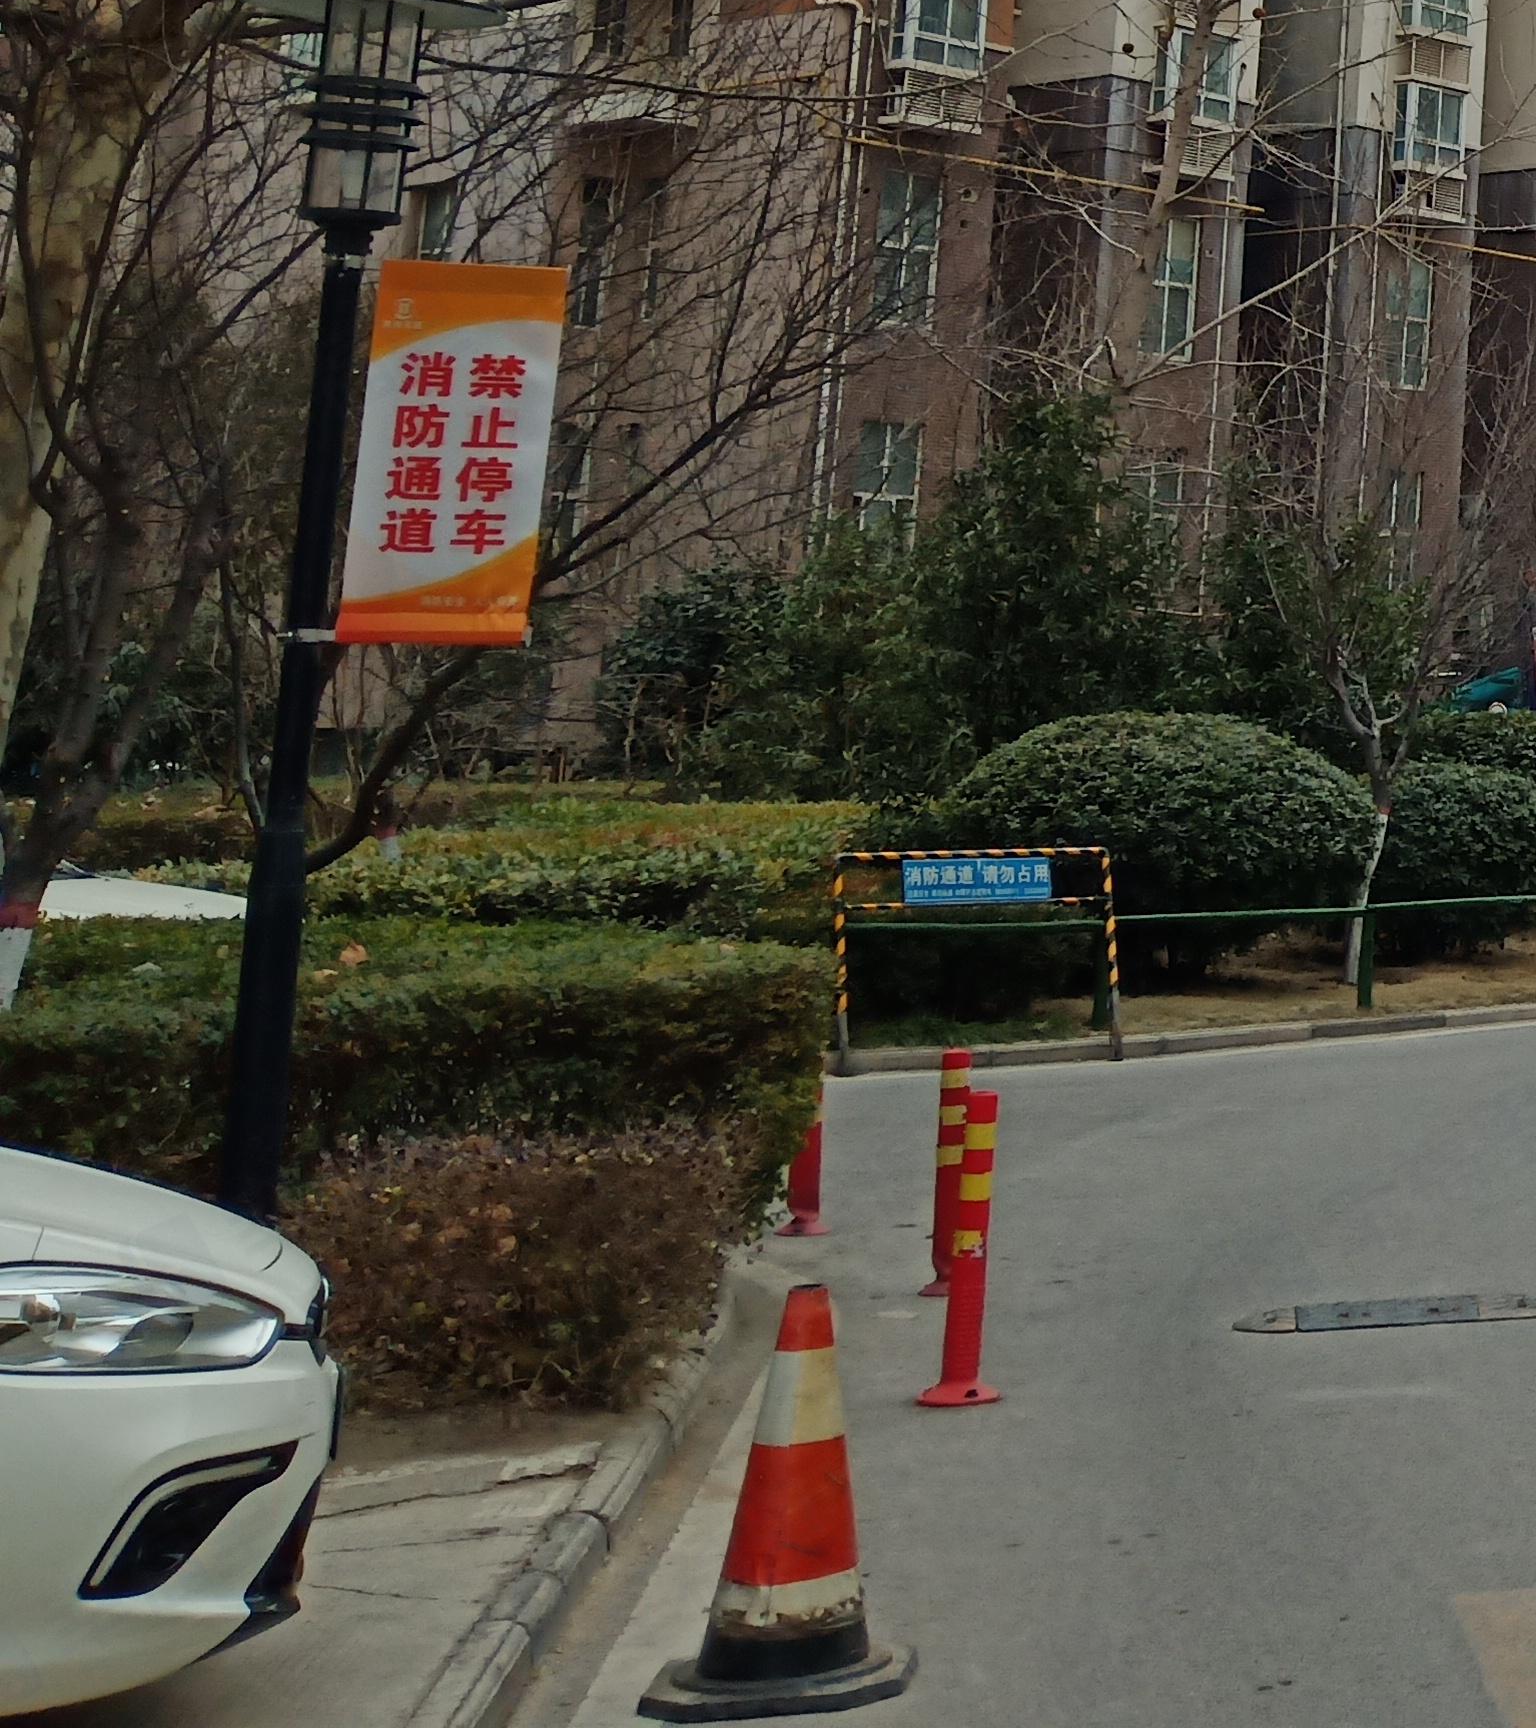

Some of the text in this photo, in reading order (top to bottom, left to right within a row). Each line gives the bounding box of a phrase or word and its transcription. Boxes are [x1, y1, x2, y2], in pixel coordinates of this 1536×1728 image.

[379, 351, 456, 553] 消防通道
[450, 354, 526, 555] 禁止停车
[905, 864, 1049, 886] 消防通道 请勿占用
